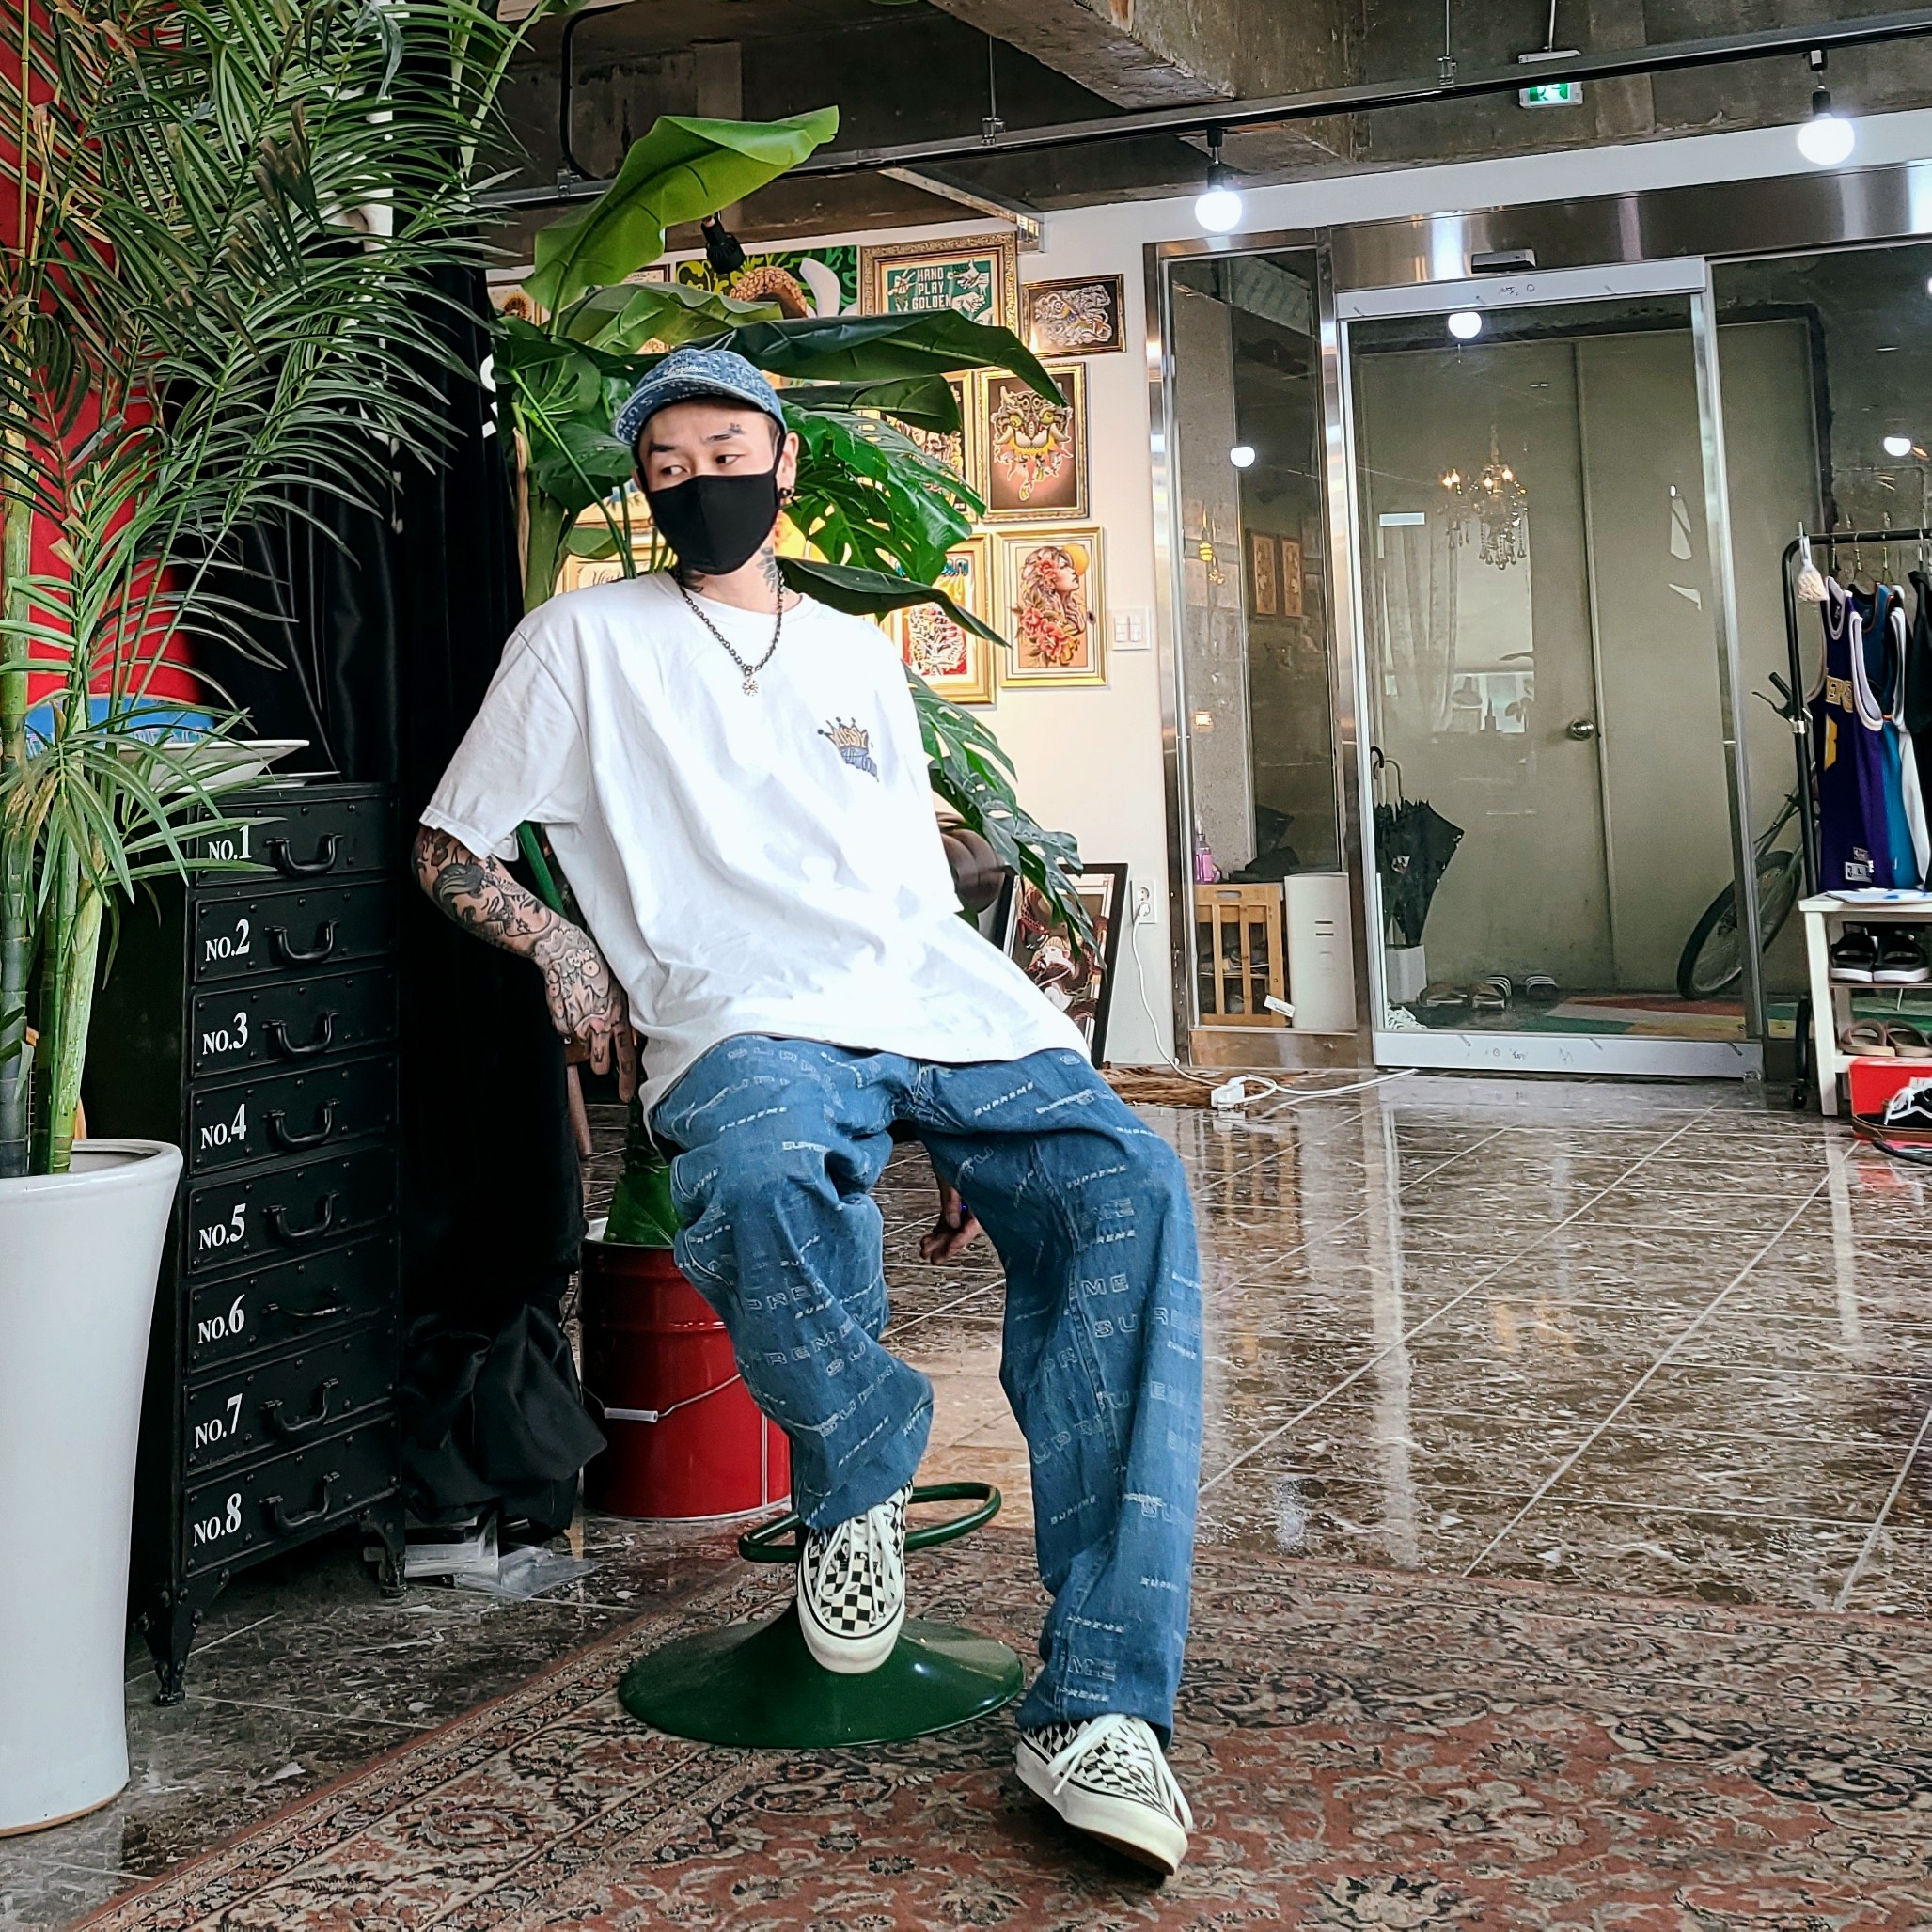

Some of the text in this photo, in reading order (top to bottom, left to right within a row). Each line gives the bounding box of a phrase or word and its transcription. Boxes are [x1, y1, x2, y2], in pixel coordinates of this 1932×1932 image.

[917, 267, 944, 282] HAND
[918, 281, 944, 296] PLAY
[912, 294, 951, 310] GOLDEN
[208, 825, 252, 861] NO.1
[205, 919, 250, 961] NO.2
[202, 1012, 248, 1055] NO.3
[973, 1080, 1034, 1117] SUPREME
[200, 1104, 247, 1149] NO.4
[1066, 1164, 1126, 1189] SUPREME
[198, 1203, 246, 1250] NO.5
[197, 1294, 245, 1343] NO.6
[194, 1393, 243, 1448] NO.7
[193, 1492, 242, 1547] NO.8
